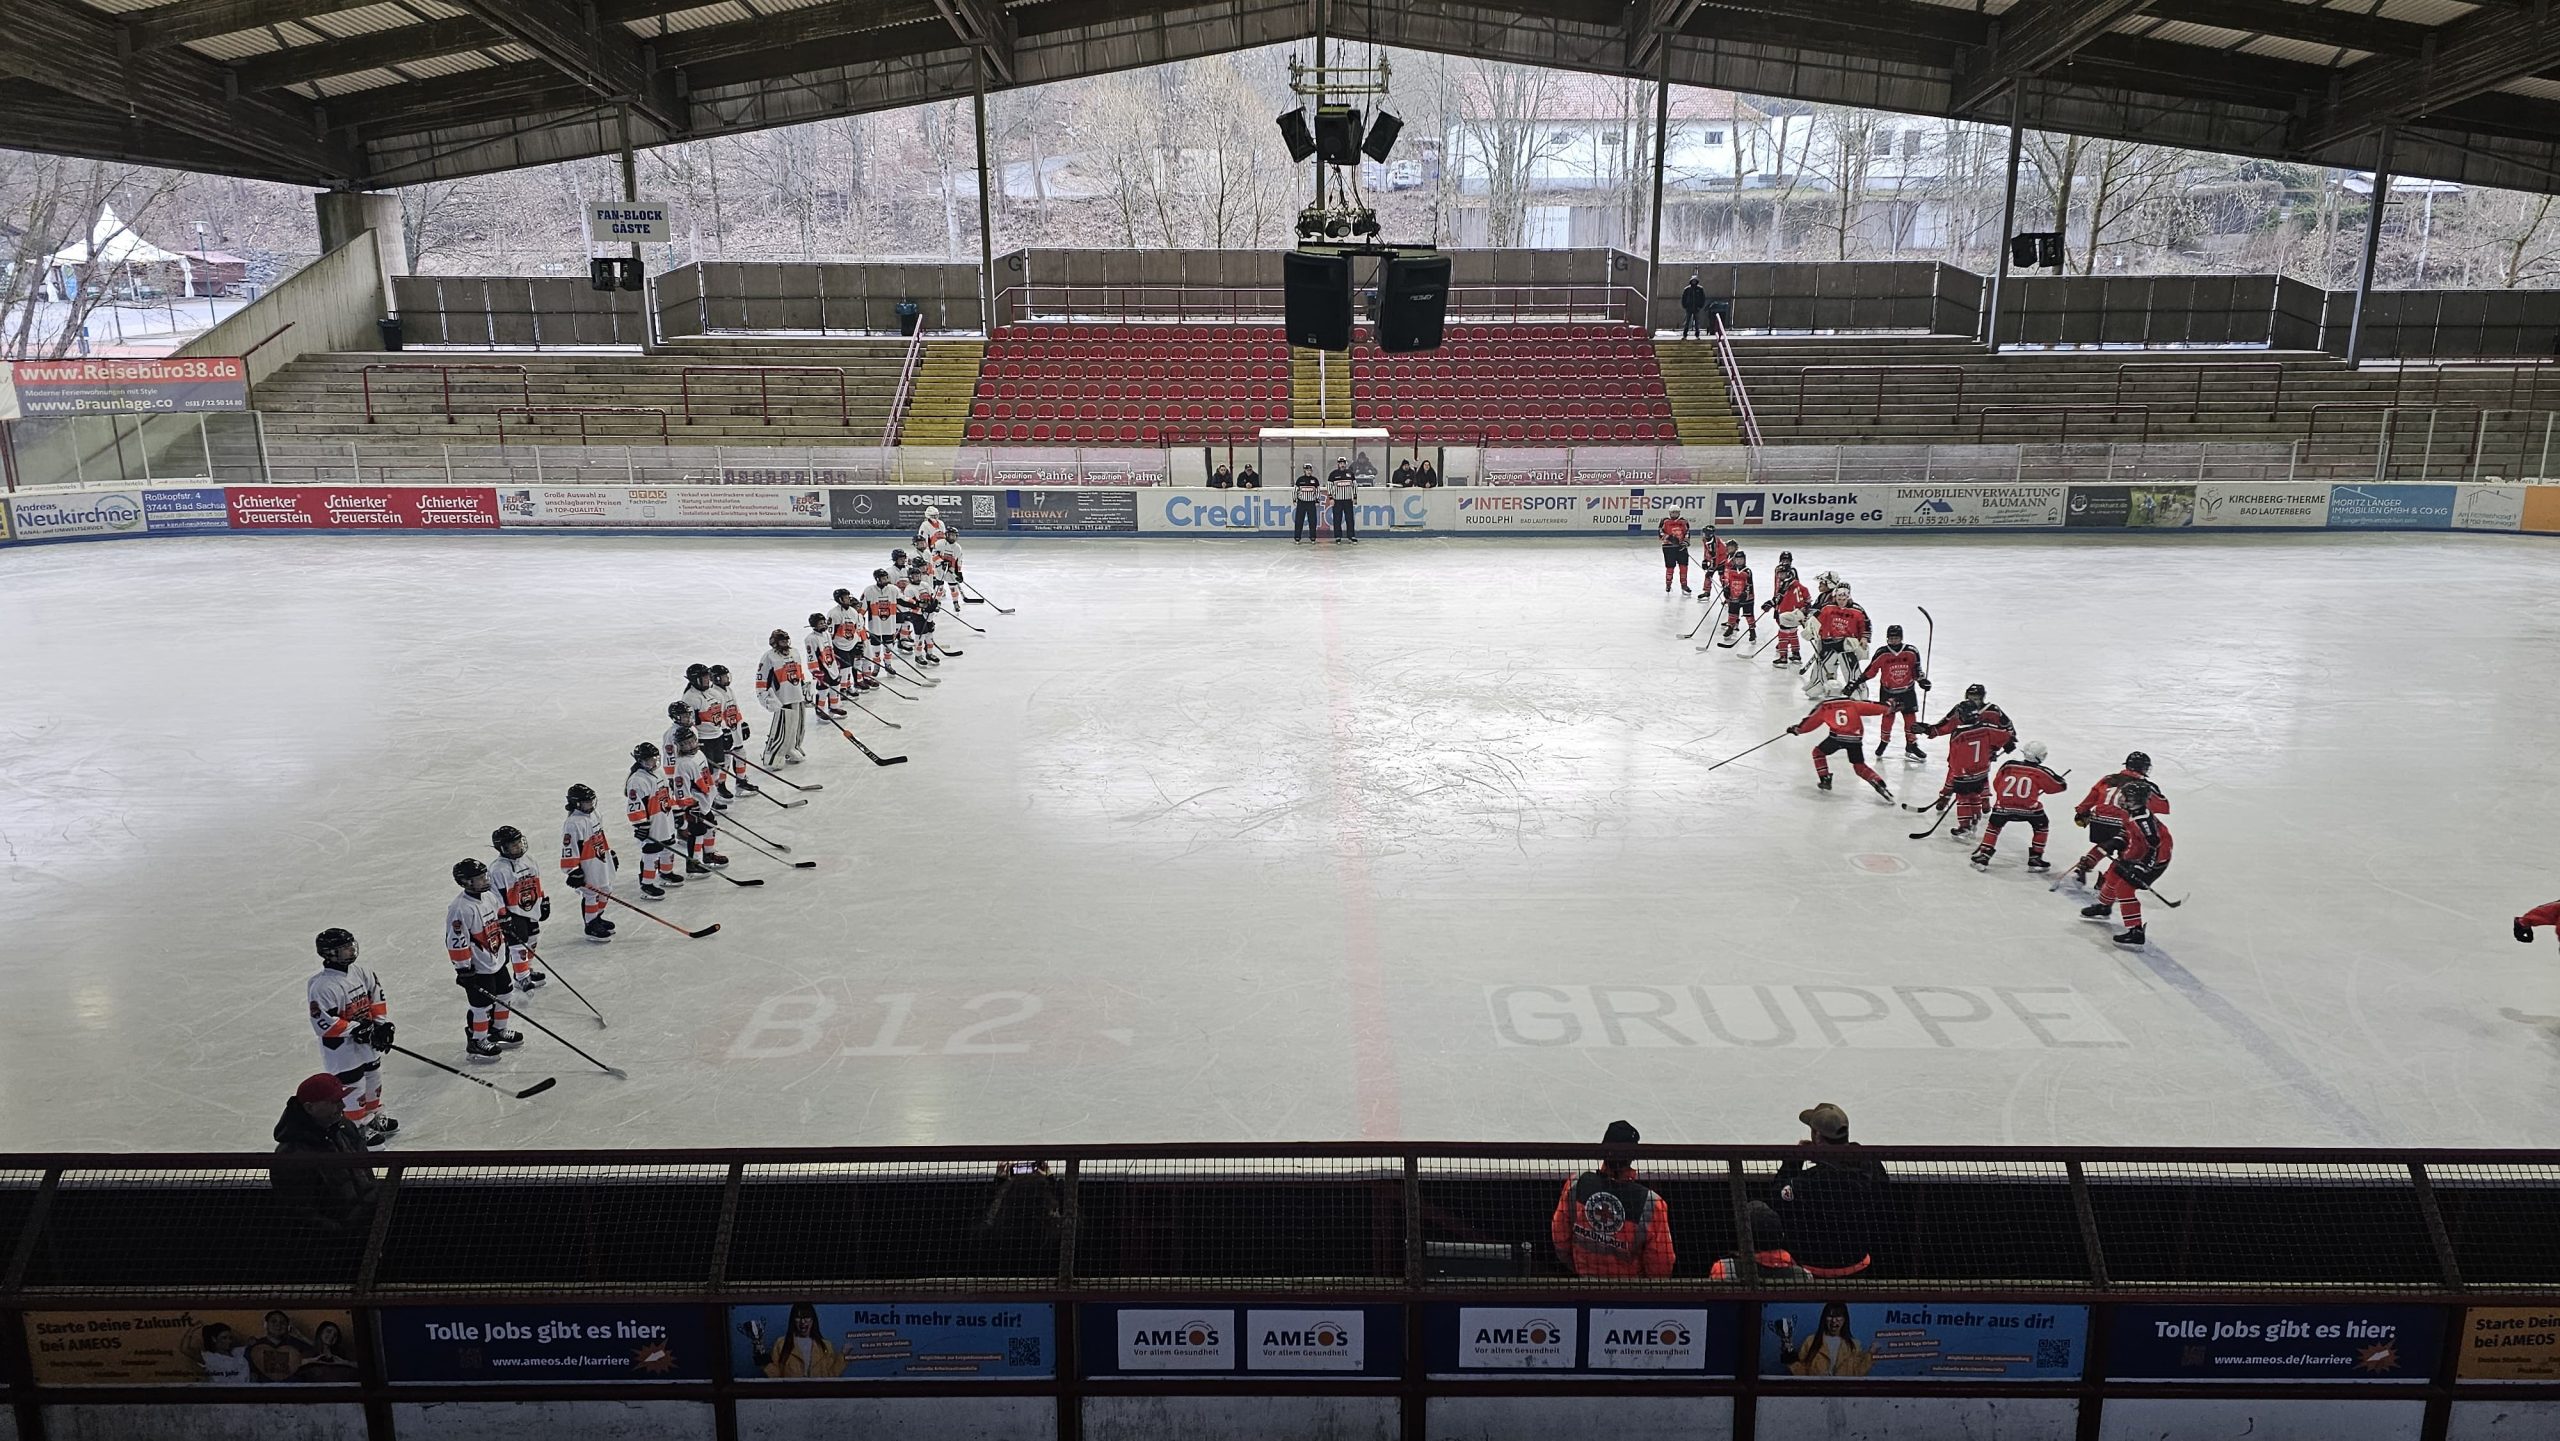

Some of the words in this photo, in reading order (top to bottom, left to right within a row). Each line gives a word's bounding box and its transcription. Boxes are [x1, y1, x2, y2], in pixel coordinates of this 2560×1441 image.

[597, 210, 662, 220] FAN-BLOCK
[612, 221, 651, 234] GÄSTE
[20, 361, 237, 381] www.Reisebüro38.de
[25, 389, 60, 397] Moderne
[140, 388, 158, 396] Style
[27, 397, 173, 411] www.Braunlage.co
[996, 470, 1034, 480] Spedition
[1087, 472, 1123, 480] Spedition
[1488, 470, 1525, 481] Spedition
[1577, 469, 1613, 480] Spedition
[145, 492, 194, 501] Roßkopfstr.
[629, 490, 668, 498] UTAX
[1771, 492, 1858, 505] Volksbank
[1897, 487, 2061, 499] IMMOBILIENVERWALTUNG
[2229, 495, 2326, 504] KIRCHBERG-THERME
[146, 503, 172, 511] 37441
[193, 502, 226, 510] Sachsa
[233, 495, 296, 509] Schierker
[324, 495, 388, 509] Schierker
[416, 495, 479, 509] Schierker
[545, 499, 595, 507] unschlagbaren
[897, 495, 962, 506] ROSIER
[1475, 496, 1577, 510] INTERSPORT
[1602, 496, 1706, 510] INTERSPORT
[1982, 497, 2047, 508] BAUMANN
[16, 503, 57, 512] Andreas
[2259, 507, 2312, 515] LAUTERBERG
[2332, 506, 2381, 514] IMMOBILIEN
[17, 507, 141, 527] Neukirchner
[239, 509, 312, 524] Feuerstein
[330, 509, 403, 524] Feuerstein
[421, 509, 494, 524] Feuerstein
[838, 517, 890, 525] Mercedes-Benz
[1011, 510, 1061, 519] HIGHWAY
[1466, 514, 1513, 524] RUDOLPHI
[1593, 514, 1641, 524] RUDOLPHI
[1770, 509, 1855, 525] Braunlage
[1860, 510, 1883, 521] eG
[1895, 516, 1916, 525] TEL.
[1918, 516, 1925, 525] 0
[1925, 516, 1937, 525] 55
[1937, 516, 1949, 524] 20
[1956, 516, 1968, 524] 36
[1968, 516, 1980, 524] 26
[1835, 709, 1848, 727] 6
[1968, 741, 1981, 764] 7
[2002, 776, 2032, 799] 20
[629, 801, 642, 811] 27
[452, 937, 468, 948] 22
[1489, 985, 2130, 1048] GRUPPE
[317, 1018, 329, 1031] 6
[725, 989, 1042, 1058] B12
[36, 1321, 84, 1335] Starte
[87, 1318, 131, 1332] Deine
[134, 1312, 194, 1330] Zukunft
[854, 1310, 900, 1325] Mach
[905, 1311, 952, 1325] mehr
[956, 1315, 987, 1327] aus
[991, 1312, 1022, 1328] dir!
[1885, 1310, 1931, 1325] Mach
[1936, 1311, 1984, 1327] mehr
[1988, 1315, 2019, 1328] aus
[2024, 1313, 2054, 1329] dir!
[2476, 1318, 2524, 1330] Starte
[425, 1322, 479, 1340] Tolle
[484, 1322, 532, 1342] Jobs
[537, 1320, 582, 1344] gibt
[586, 1326, 612, 1339] es
[617, 1319, 666, 1339] hier:
[1476, 1329, 1561, 1344] AMEOS
[2155, 1320, 2207, 1338] Tolle
[2211, 1320, 2261, 1341] Jobs
[2265, 1319, 2310, 1342] gibt
[2315, 1325, 2341, 1338] es
[2345, 1319, 2396, 1339] hier:
[1134, 1330, 1219, 1345] AMEOS
[1263, 1331, 1348, 1346] AMEOS
[1605, 1330, 1690, 1345] AMEOS
[2475, 1334, 2498, 1348] bei
[2501, 1333, 2555, 1346] AMEOS
[40, 1338, 65, 1352] bei
[69, 1337, 122, 1351] AMEOS
[1303, 1349, 1348, 1357] Gesundheit
[1644, 1348, 1689, 1356] Gesundheit
[492, 1354, 630, 1367] www.ameos.de/karriere
[2214, 1354, 2353, 1366] www.ameos.de/karriere
